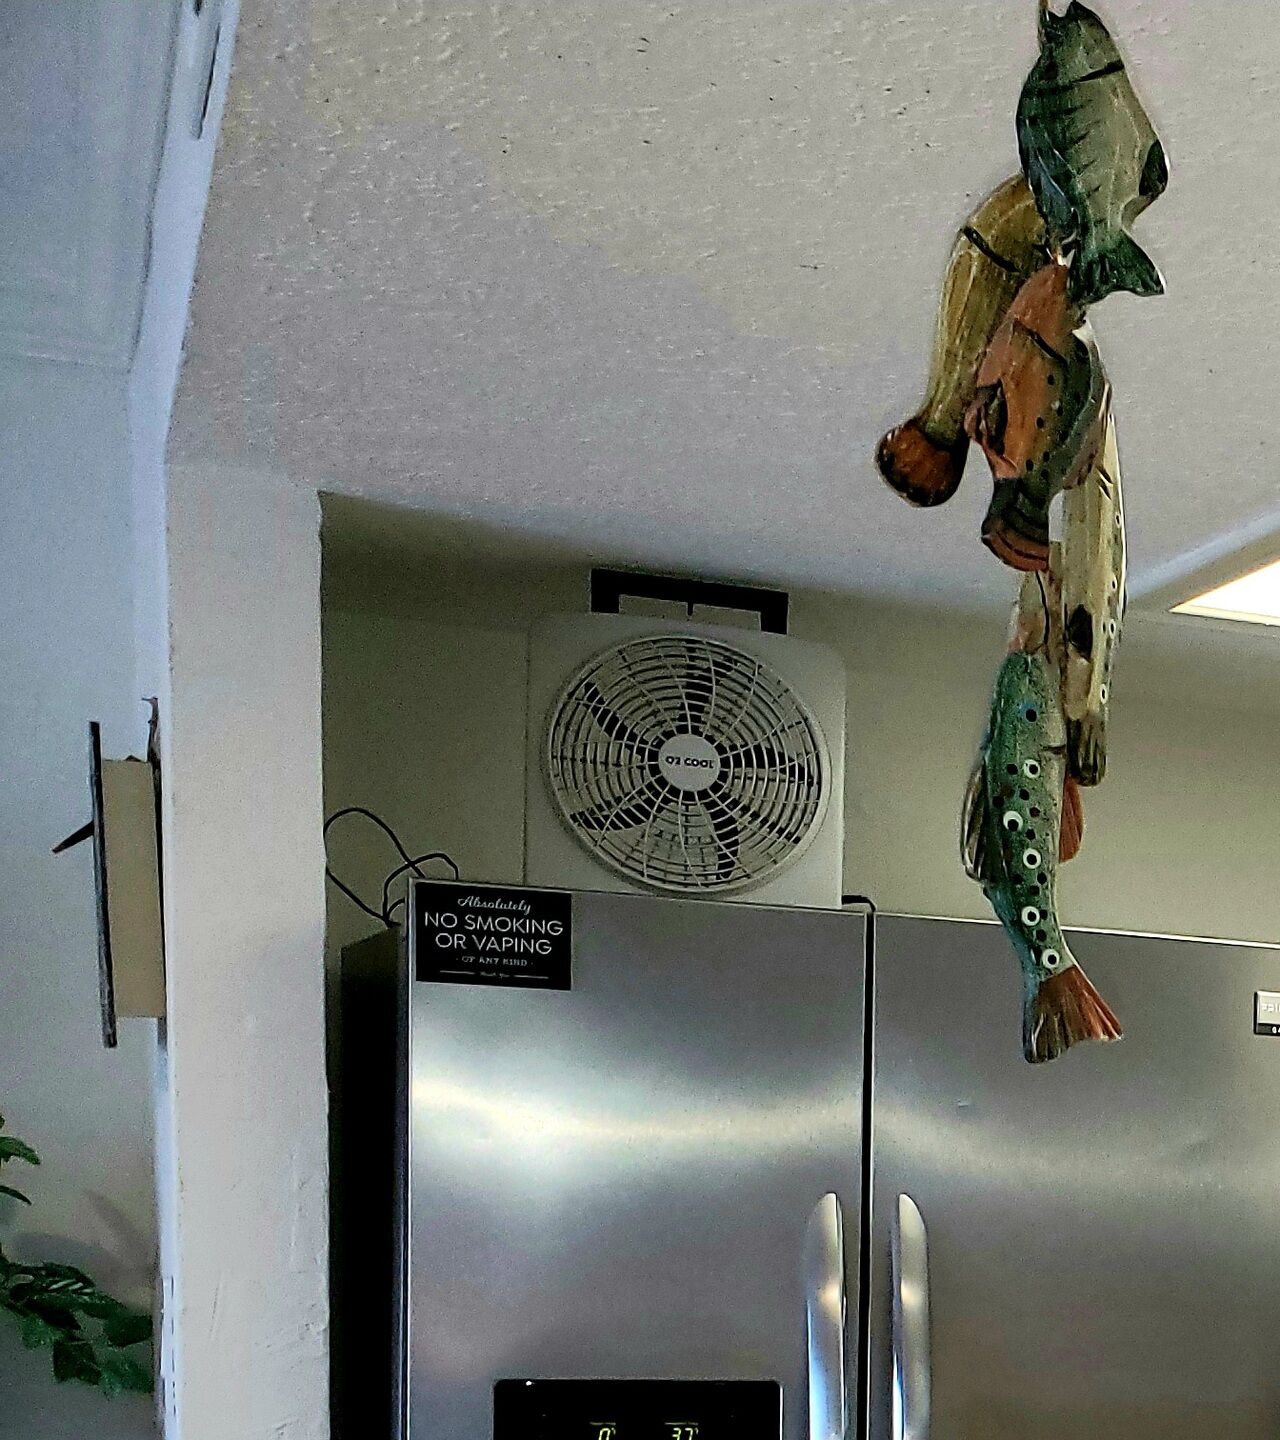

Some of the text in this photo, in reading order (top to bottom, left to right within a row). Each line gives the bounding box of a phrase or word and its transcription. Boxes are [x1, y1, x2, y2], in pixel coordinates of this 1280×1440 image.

[457, 895, 531, 915] Absolutely
[424, 911, 564, 936] NO SMOKING
[435, 932, 552, 955] OR VAPING
